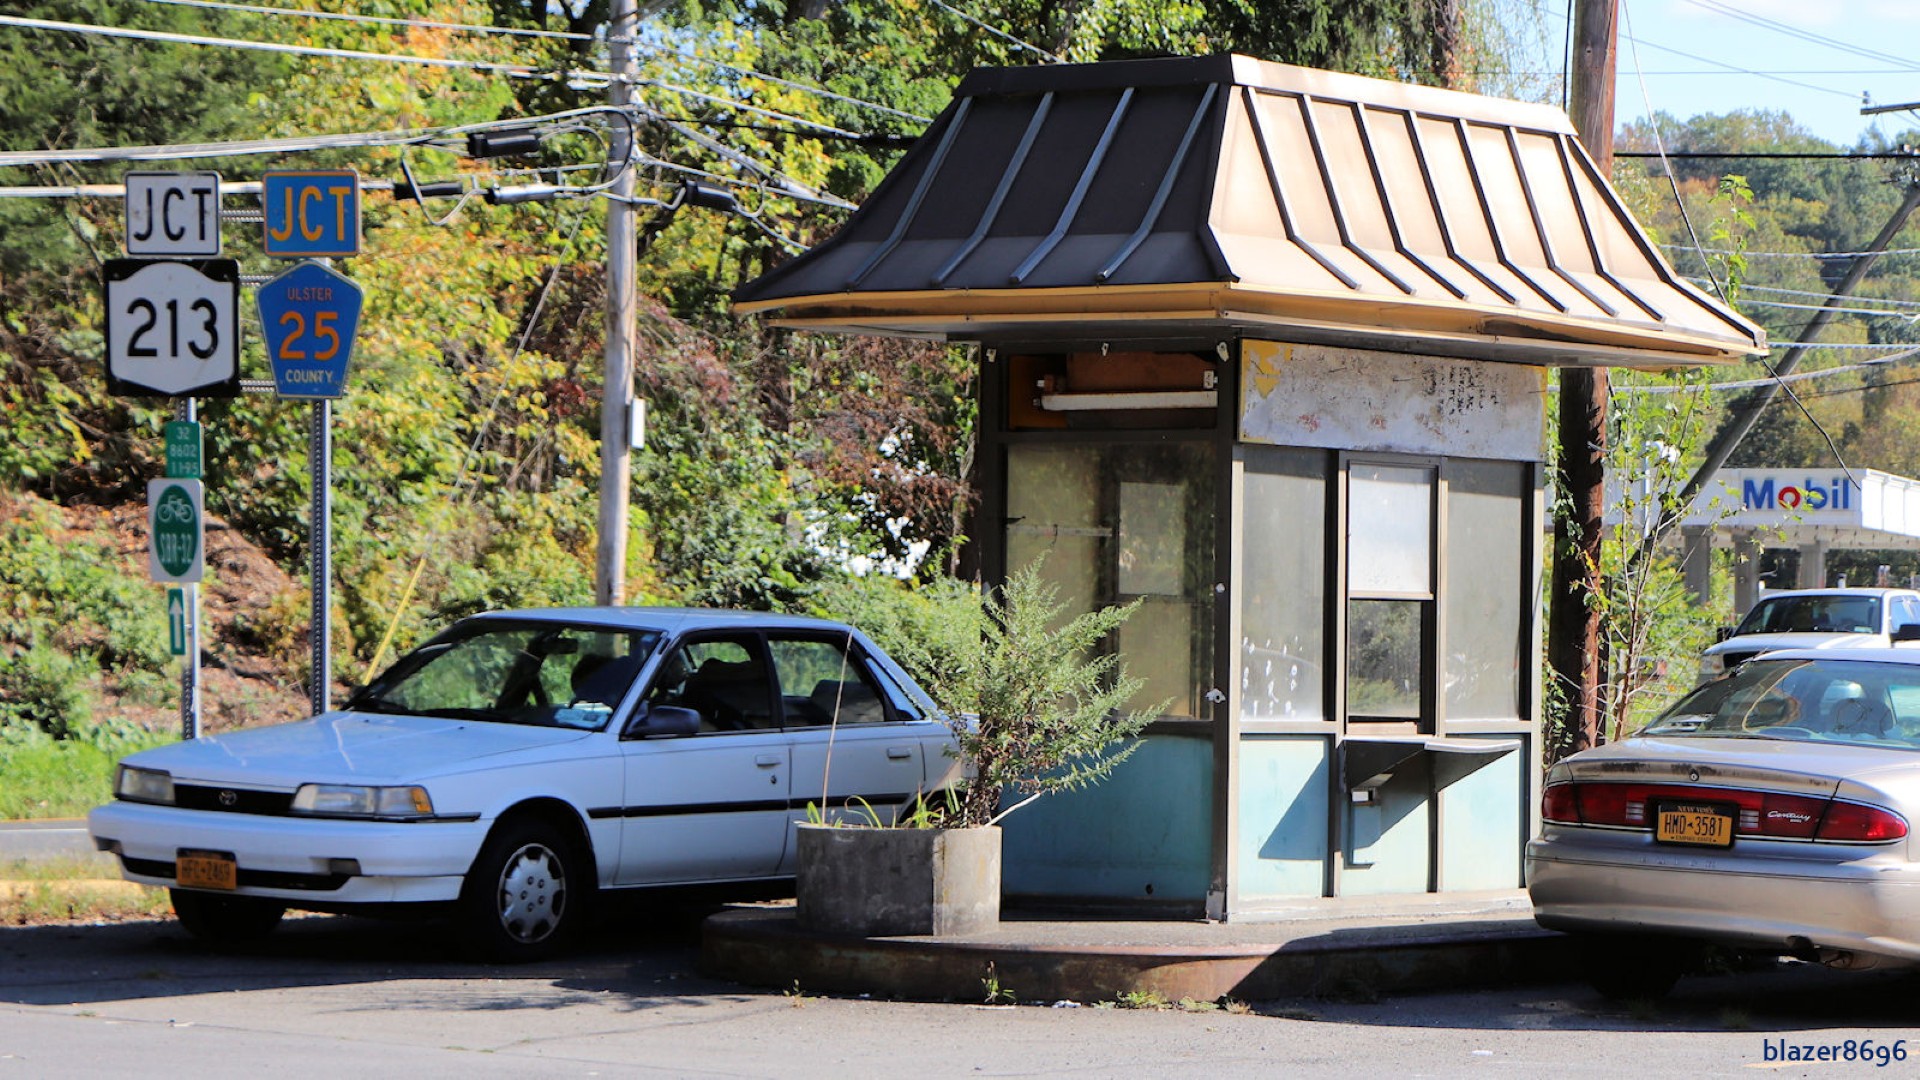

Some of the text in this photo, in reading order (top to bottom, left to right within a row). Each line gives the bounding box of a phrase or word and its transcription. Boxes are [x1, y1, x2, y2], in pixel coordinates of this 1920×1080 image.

[133, 187, 212, 242] JCT
[270, 186, 350, 242] JCT
[288, 287, 332, 301] ULSTER
[127, 298, 218, 359] 213
[279, 311, 340, 361] 25
[286, 369, 333, 384] COUNTY
[1743, 476, 1849, 510] Mobil
[1767, 810, 1811, 822] Century
